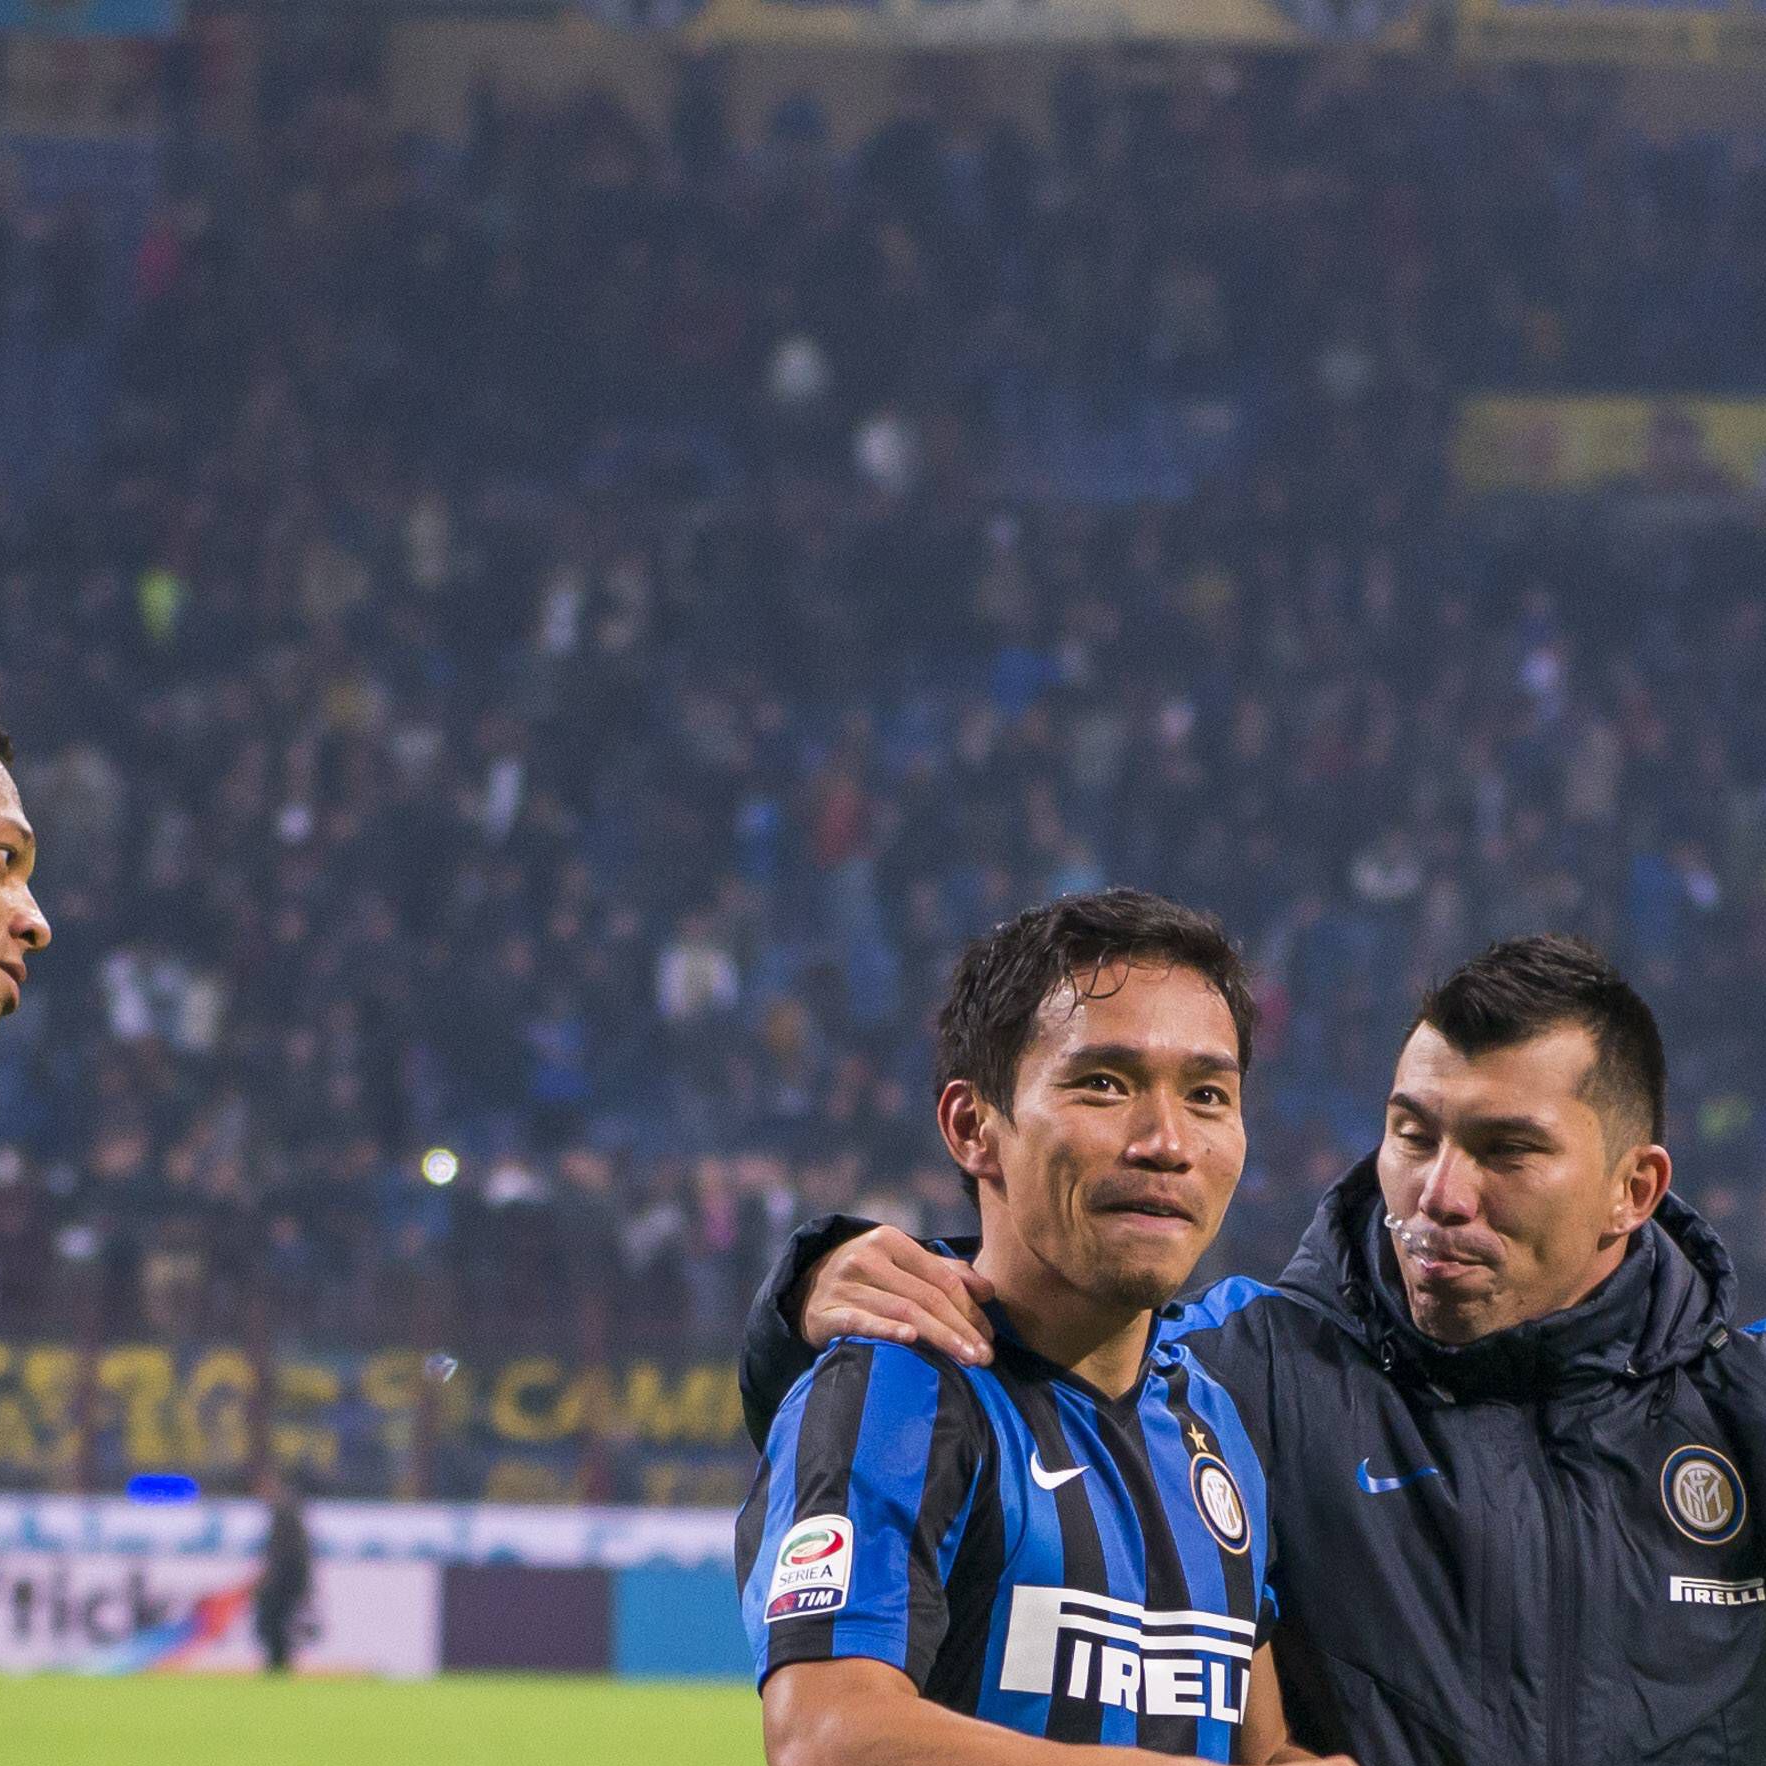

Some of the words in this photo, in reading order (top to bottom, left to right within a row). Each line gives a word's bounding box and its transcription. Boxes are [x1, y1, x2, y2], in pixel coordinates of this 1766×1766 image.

[779, 1566, 819, 1587] SERIE
[820, 1564, 833, 1577] A
[797, 1590, 834, 1608] TIM
[1669, 1575, 1766, 1606] PIRELLI
[999, 1584, 1257, 1725] PIREL
